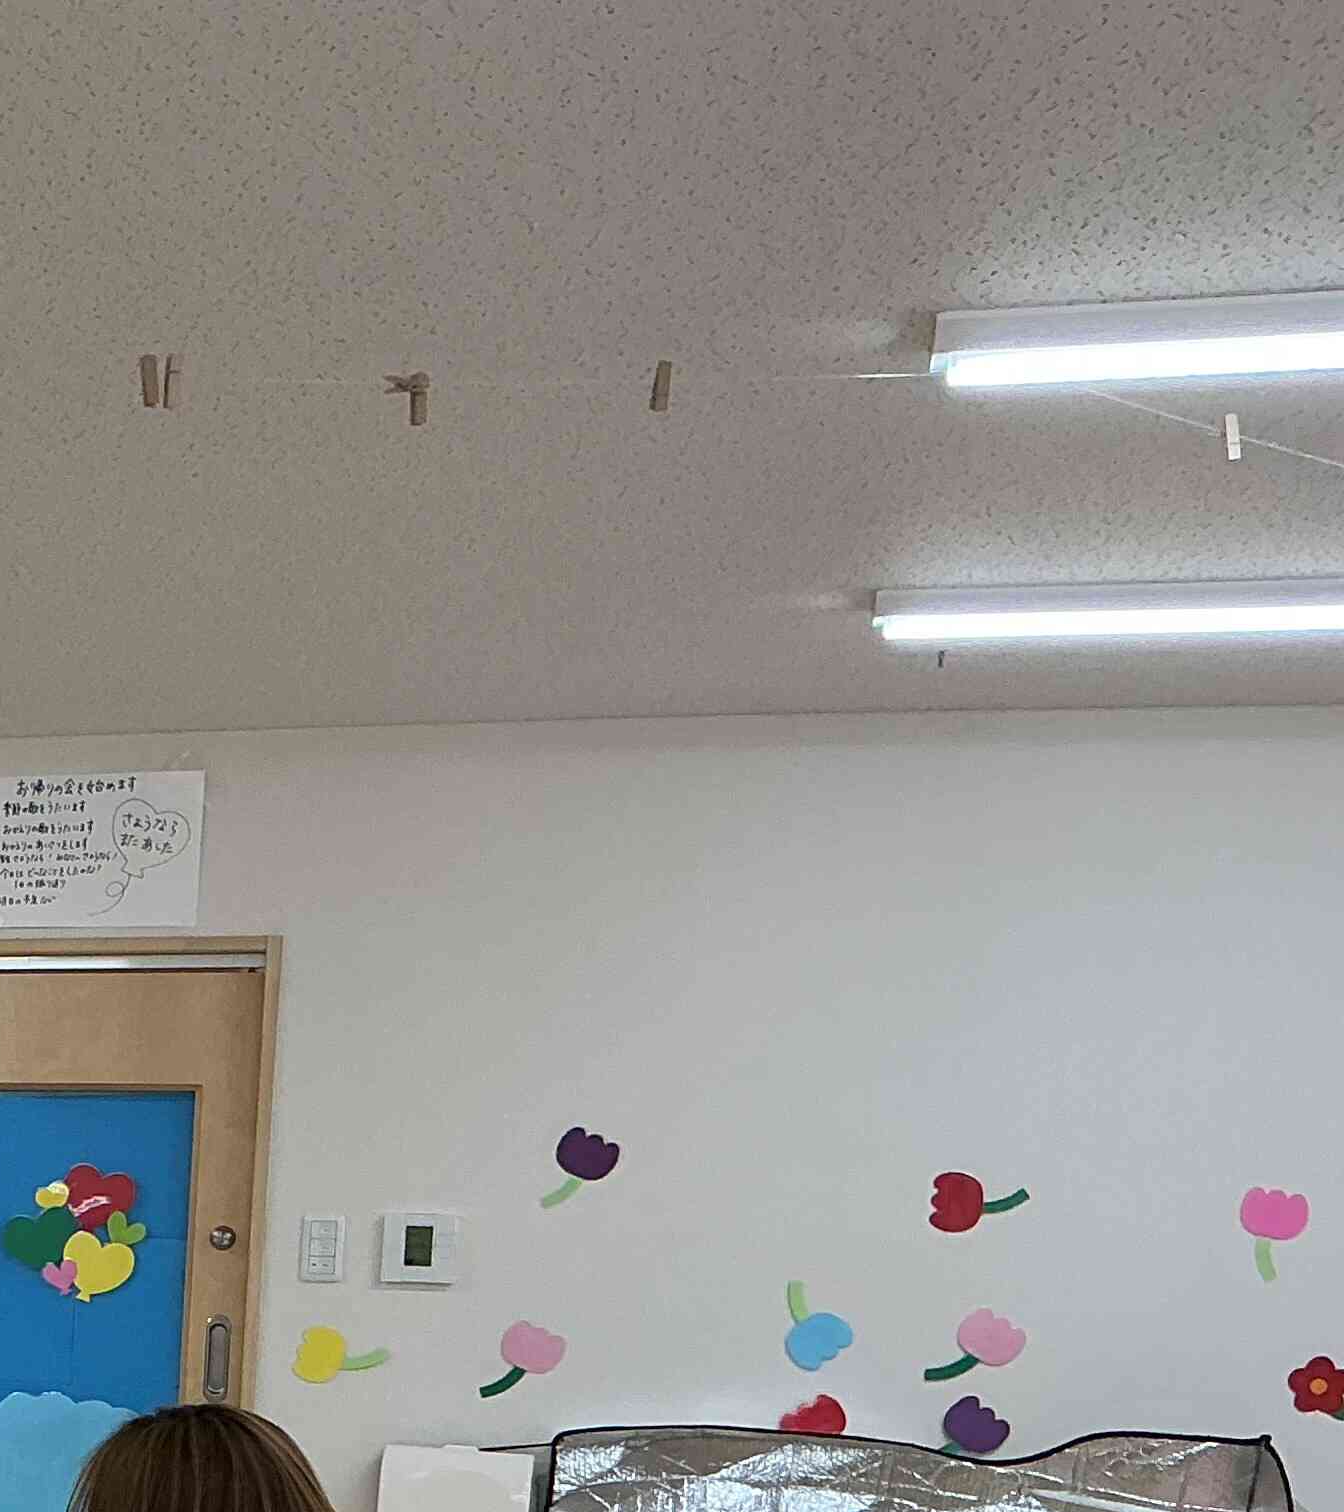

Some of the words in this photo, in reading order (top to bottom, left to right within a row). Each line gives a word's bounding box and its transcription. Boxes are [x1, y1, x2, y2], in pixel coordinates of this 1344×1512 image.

[122, 813, 179, 837] さようなら
